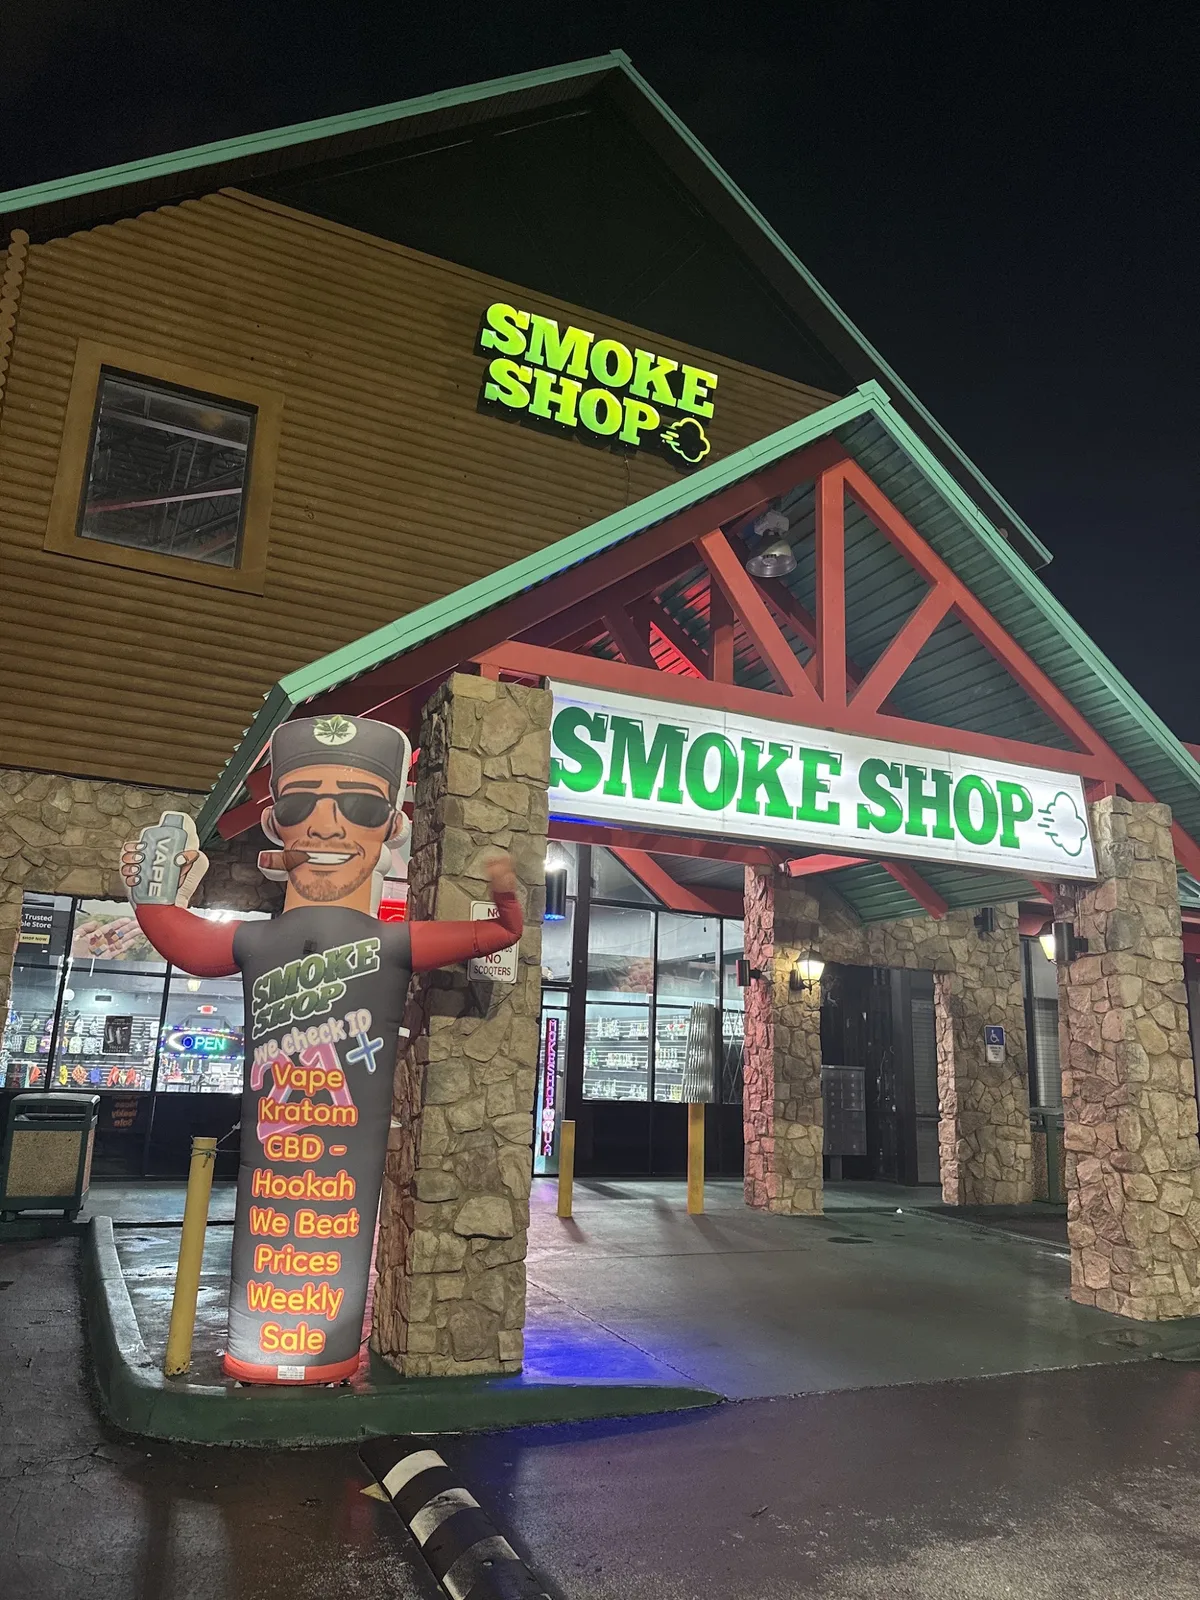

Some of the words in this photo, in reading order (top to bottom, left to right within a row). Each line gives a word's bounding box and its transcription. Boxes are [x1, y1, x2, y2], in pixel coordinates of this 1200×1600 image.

[480, 303, 718, 419] SMOKE
[484, 358, 661, 446] SHOP
[549, 706, 843, 825] SMOKE
[857, 758, 1034, 849] SHOP
[148, 837, 172, 897] VAPE
[25, 913, 53, 922] Trusted
[32, 921, 52, 929] Store
[474, 965, 512, 977] SCOOTERS
[485, 954, 502, 964] NO
[252, 937, 380, 1015] SMOKE
[252, 981, 346, 1039] SHOP
[345, 1008, 372, 1037] ID
[183, 1036, 225, 1051] OPEN
[272, 1062, 345, 1096] Vape
[259, 1097, 357, 1125] Kratom
[265, 1134, 323, 1161] CBD
[252, 1169, 356, 1199] Hookah
[251, 1207, 289, 1235] We
[297, 1209, 359, 1237] Beat
[255, 1245, 341, 1275] Prices
[248, 1281, 344, 1319] Weekly
[261, 1322, 325, 1354] Sale
